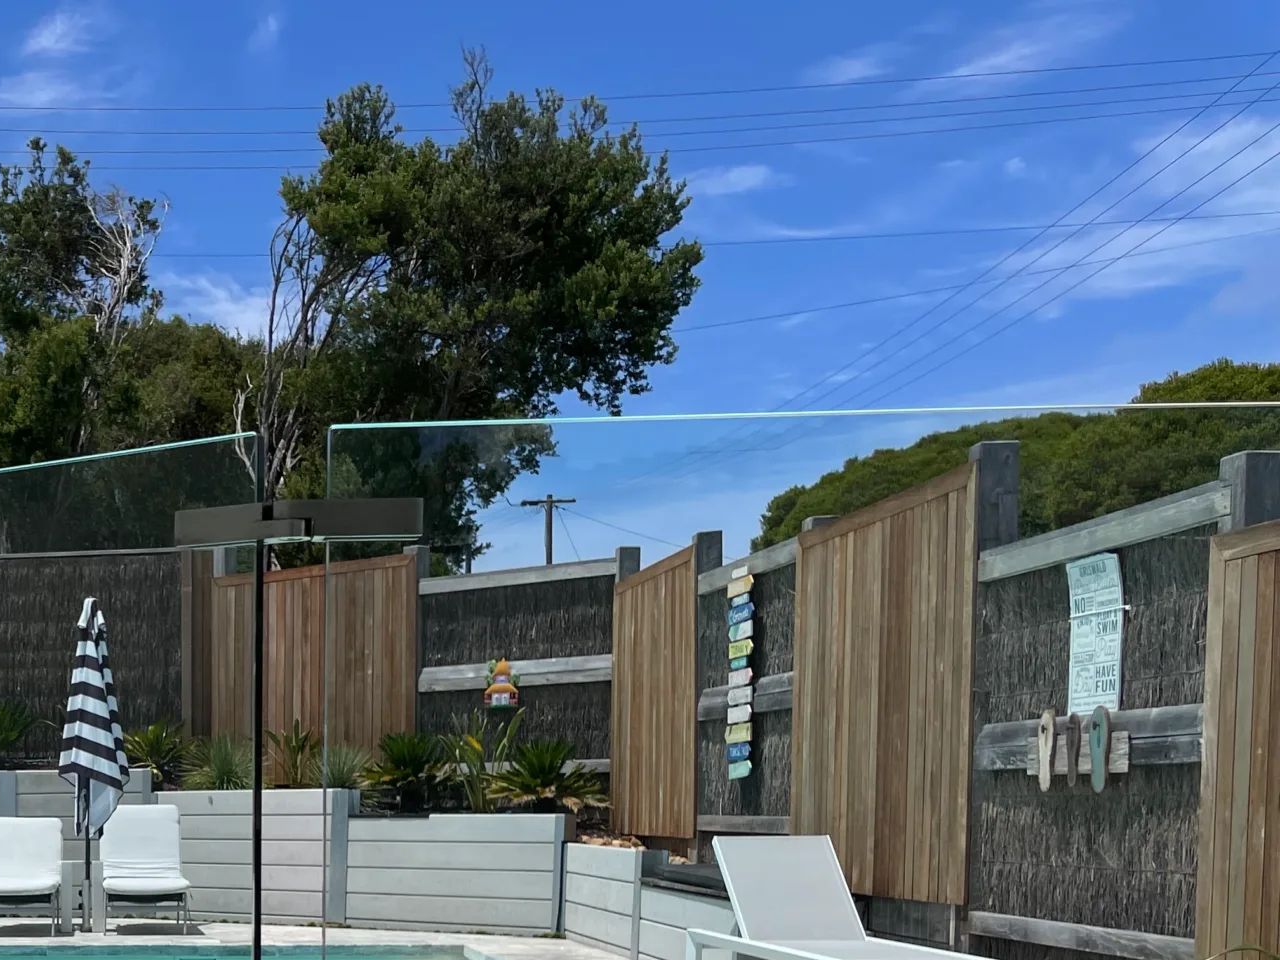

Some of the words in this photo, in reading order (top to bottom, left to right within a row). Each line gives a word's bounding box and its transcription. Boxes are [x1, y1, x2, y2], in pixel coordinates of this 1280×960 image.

[1074, 597, 1086, 614] NO
[1097, 619, 1118, 634] SWIM
[1095, 664, 1117, 679] HAVE
[1095, 678, 1116, 693] FUN
